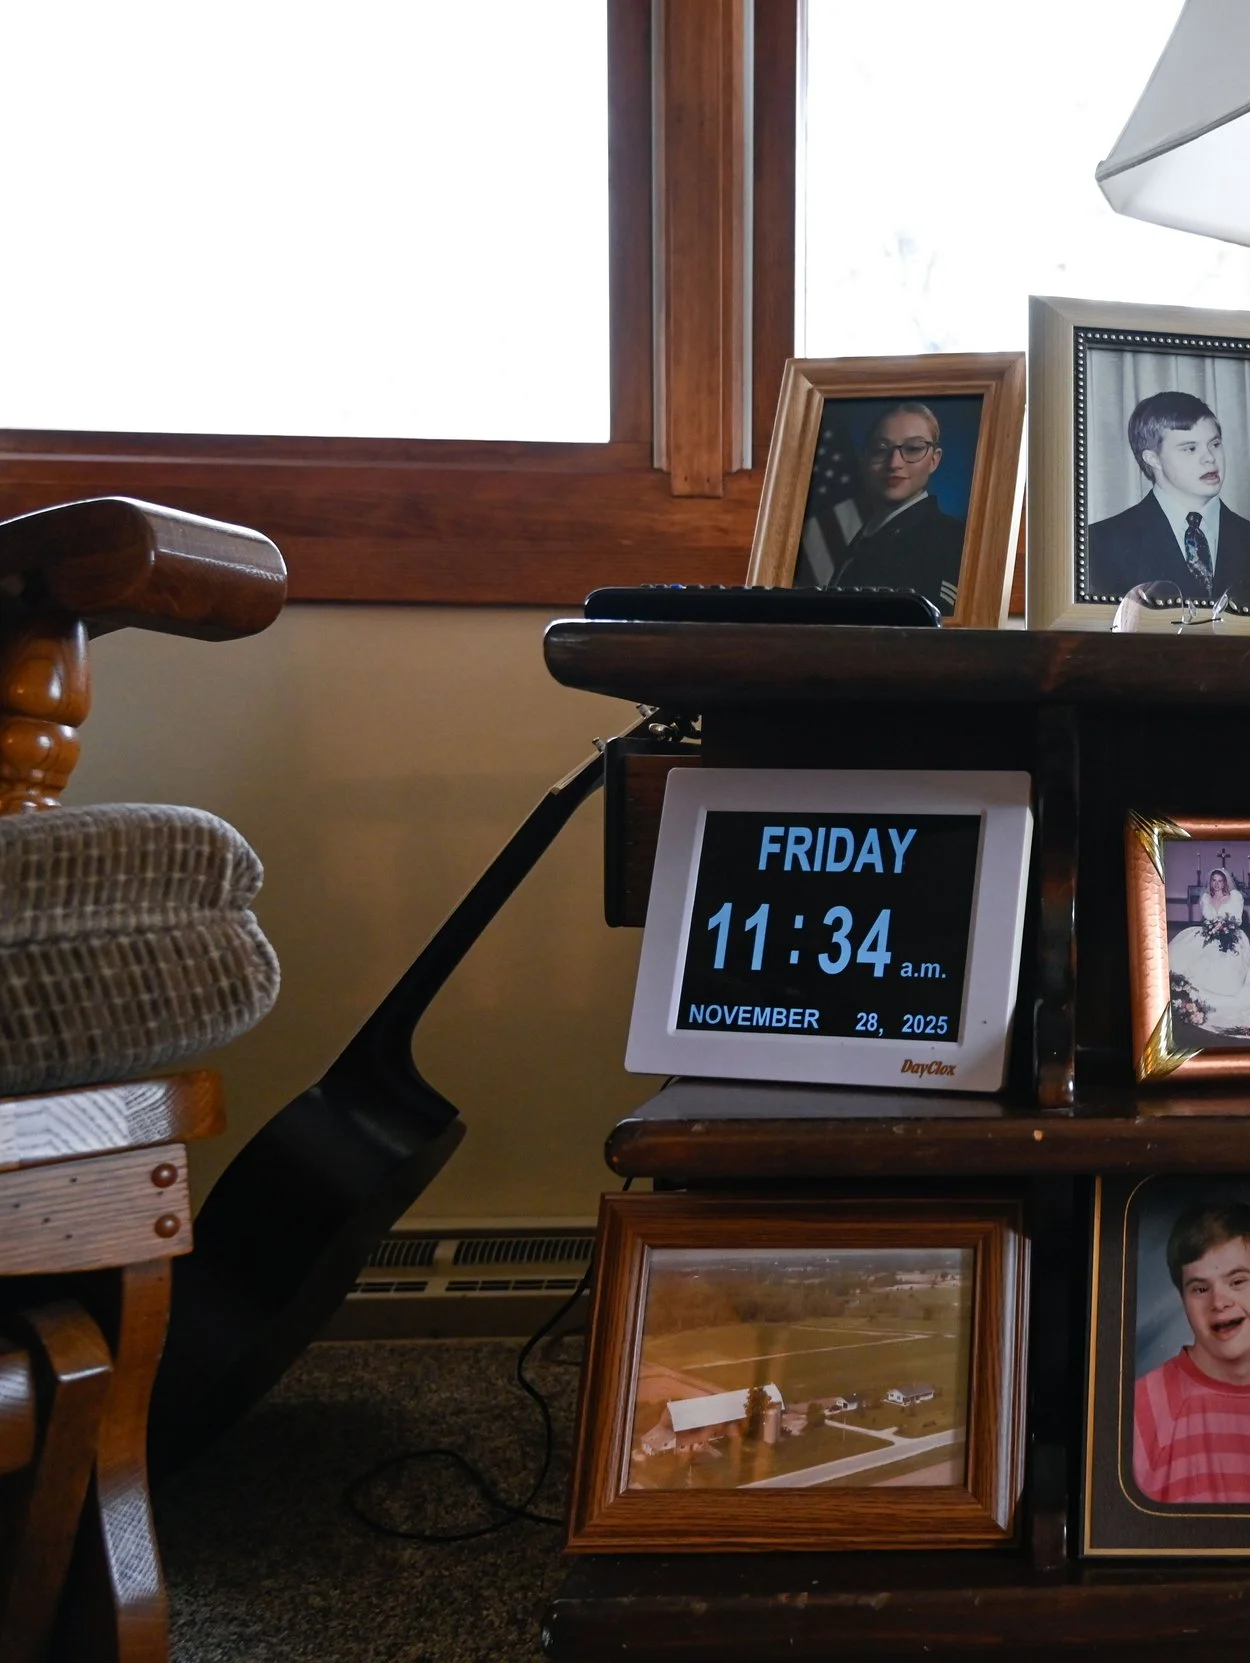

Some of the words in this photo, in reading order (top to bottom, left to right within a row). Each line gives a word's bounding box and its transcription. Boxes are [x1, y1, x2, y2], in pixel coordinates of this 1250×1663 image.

[758, 826, 917, 874] FRIDAY
[900, 961, 946, 979] a.m.
[688, 1004, 820, 1030] NOVEMBER
[855, 1012, 884, 1037] 28,
[901, 1013, 949, 1035] 2025
[900, 1060, 957, 1078] DayClox
